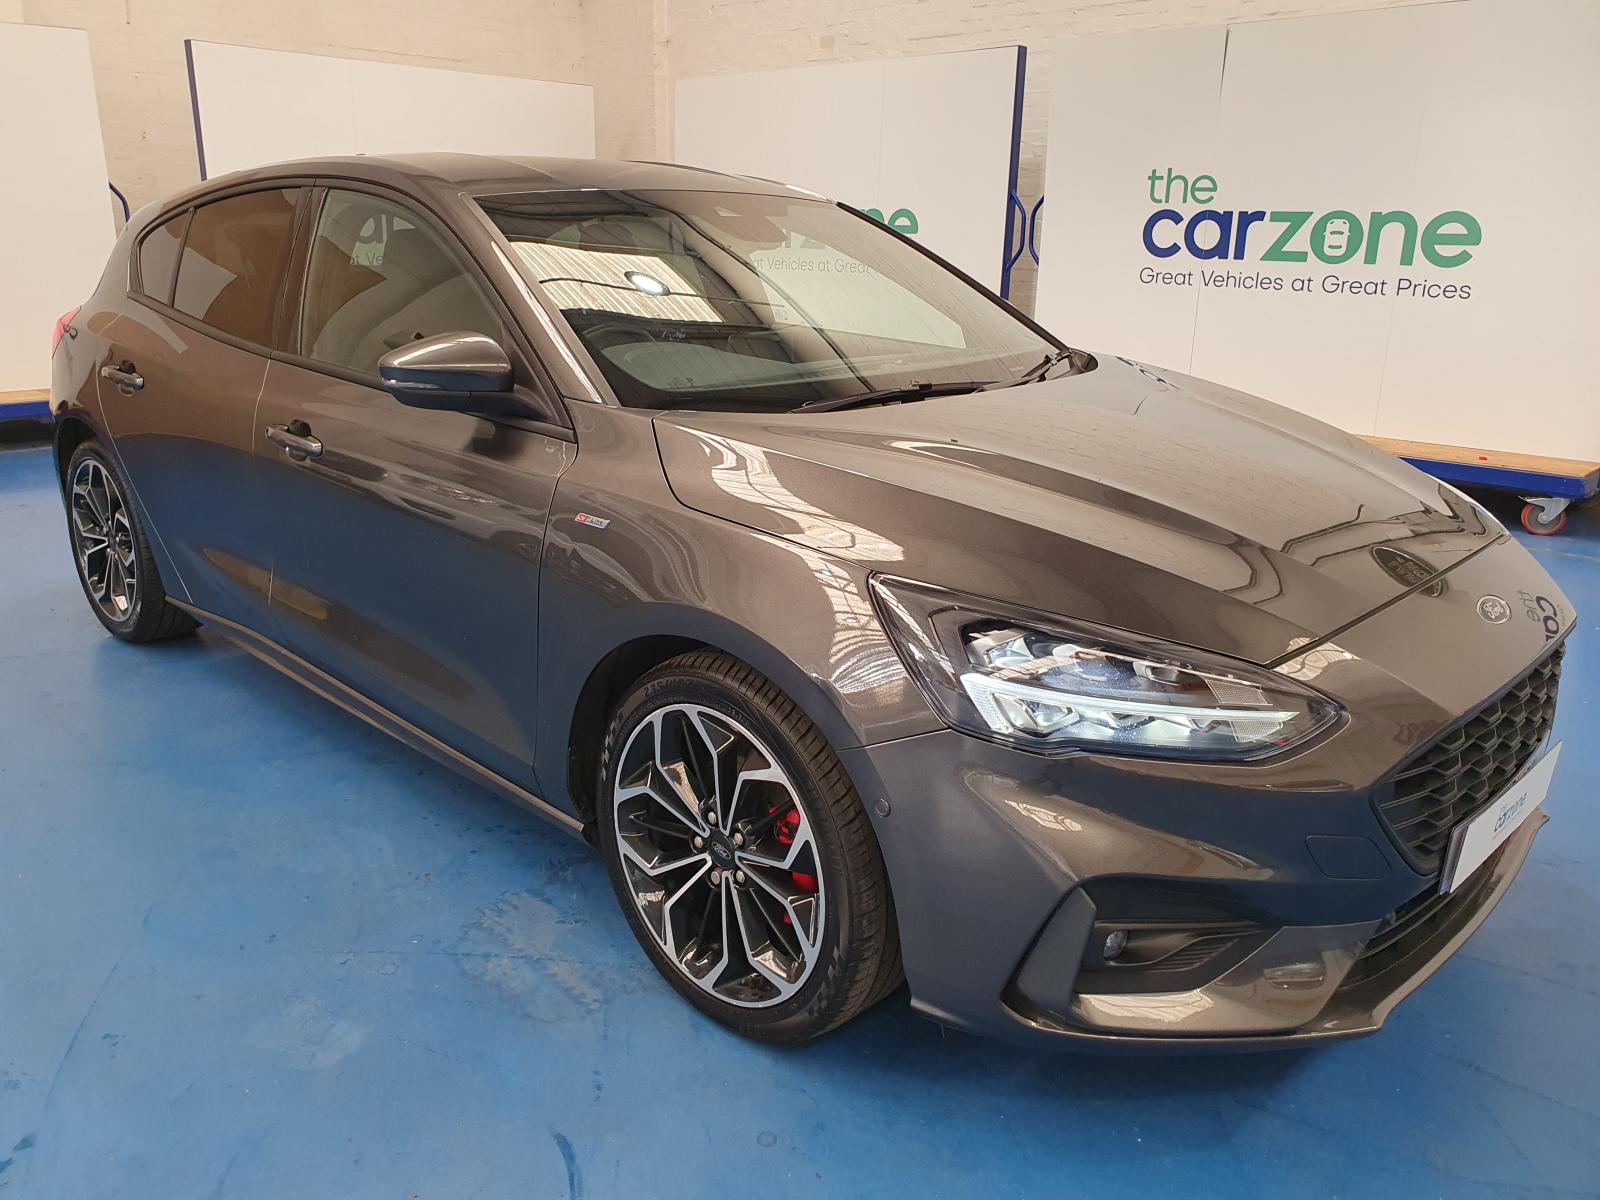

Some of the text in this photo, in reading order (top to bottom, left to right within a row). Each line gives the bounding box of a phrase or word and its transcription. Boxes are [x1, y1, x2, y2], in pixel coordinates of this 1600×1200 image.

[1147, 168, 1218, 204] the
[1142, 209, 1482, 268] carzone
[767, 256, 814, 272] Vehicles
[818, 259, 830, 272] at
[1139, 267, 1472, 300] Great Vehicles at Great Prices
